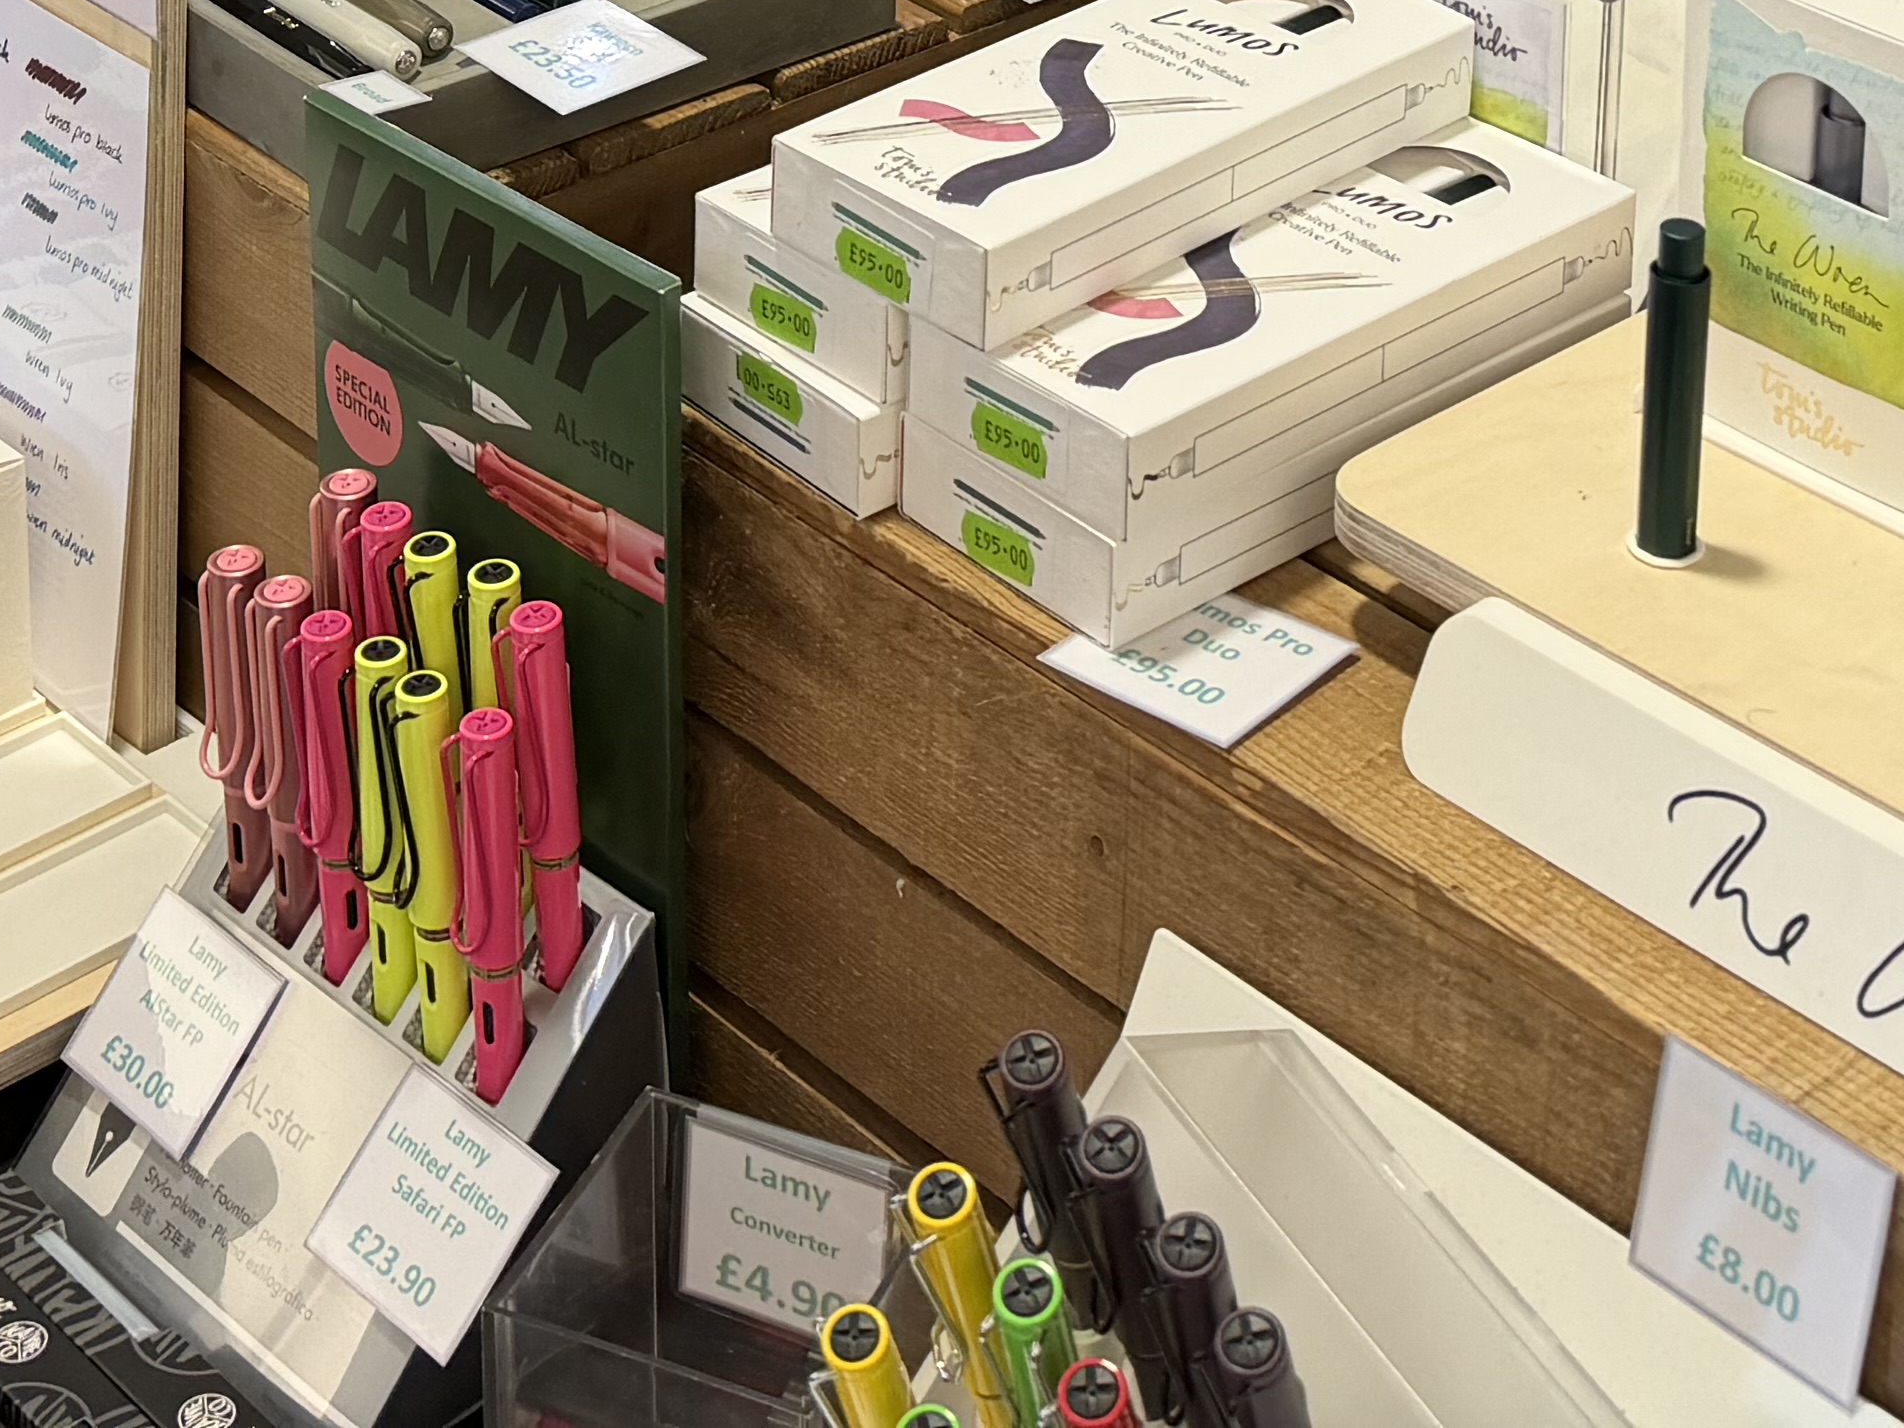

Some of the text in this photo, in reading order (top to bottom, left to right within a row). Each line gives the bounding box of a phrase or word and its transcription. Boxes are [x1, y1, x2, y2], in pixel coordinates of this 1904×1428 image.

[508, 39, 598, 89] £23.50
[316, 143, 650, 394] LAMY
[1737, 252, 1884, 333] The Infinitely Refillable
[1770, 288, 1848, 339] Writing Pen
[334, 363, 391, 417] SPECIAL
[335, 386, 393, 440] EDITION
[553, 410, 636, 477] AL-star
[1112, 647, 1226, 706] £95.00
[1181, 627, 1241, 662] Duo
[1668, 790, 1810, 964] The
[138, 940, 241, 1036] Limited Edition
[188, 935, 228, 980] Lamy
[183, 1021, 205, 1048] FP
[100, 1034, 175, 1111] £30.00
[232, 1073, 316, 1153] AL-star
[444, 1117, 492, 1169] Lamy
[1726, 1101, 1817, 1182] Lamy
[386, 1121, 510, 1232] Limited Edition
[391, 1173, 467, 1240] Safari FP
[743, 1153, 833, 1215] Lamy
[1723, 1162, 1801, 1235] Nibs
[346, 1222, 437, 1309] £23.90
[729, 1205, 841, 1259] Converter
[1693, 1231, 1802, 1324] £8.00
